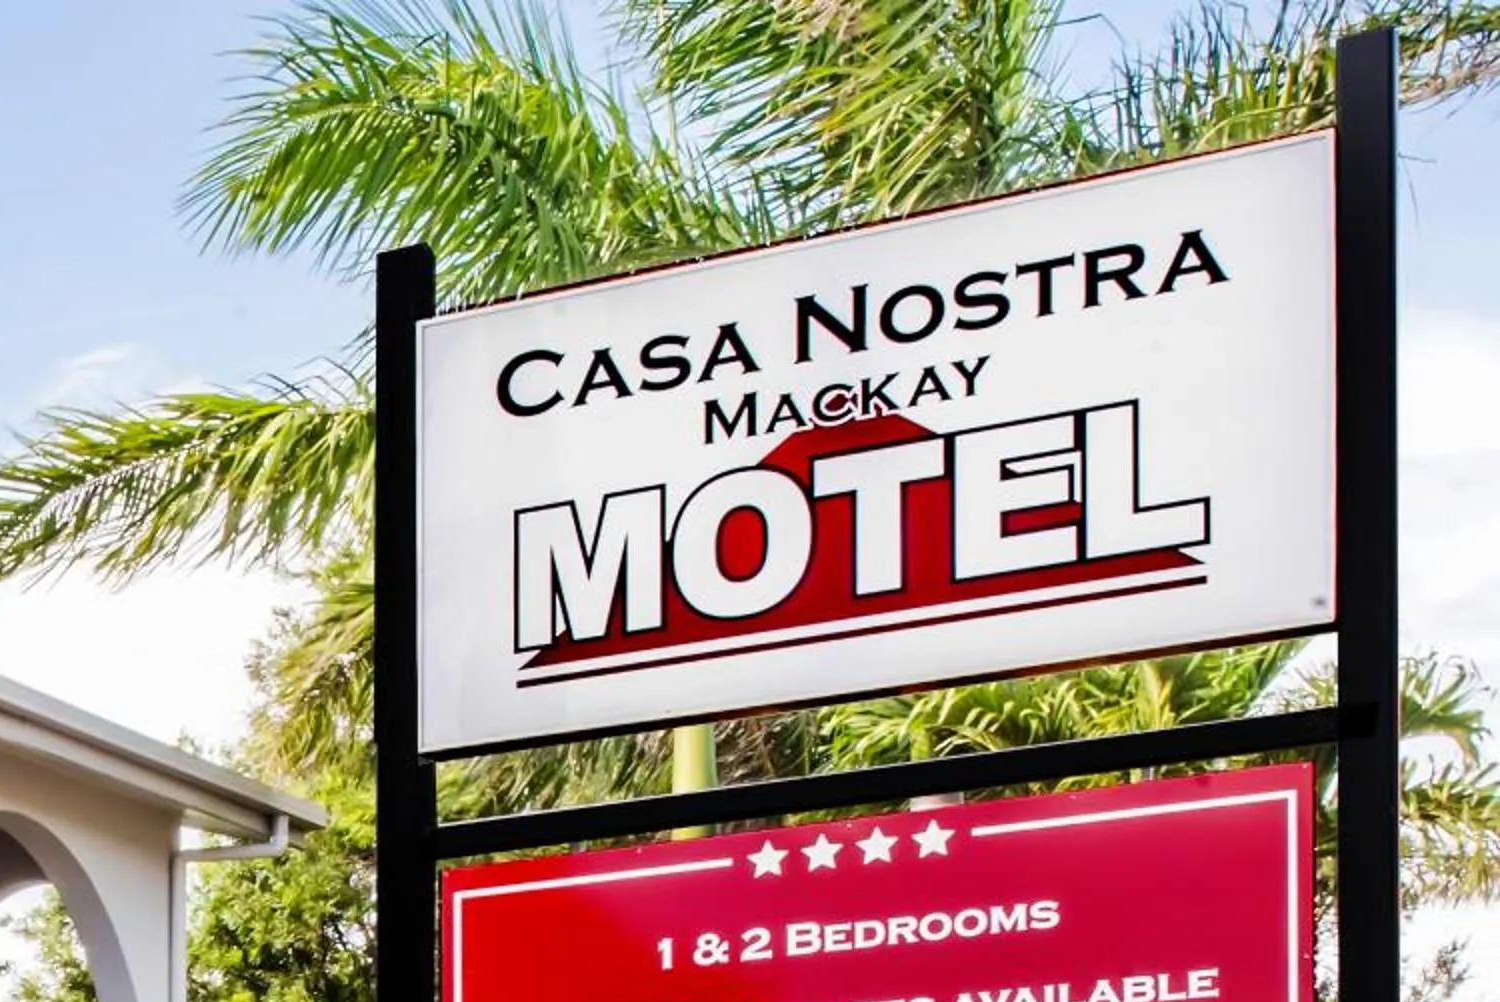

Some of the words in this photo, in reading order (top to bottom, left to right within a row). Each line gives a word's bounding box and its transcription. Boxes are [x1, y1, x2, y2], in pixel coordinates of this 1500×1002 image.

[496, 322, 760, 418] CASA
[794, 229, 1230, 365] NOSTRA
[704, 354, 991, 446] MACKAY
[514, 399, 1211, 654] MOTEL
[657, 937, 674, 970] 1
[692, 933, 728, 966] &
[742, 928, 773, 961] 2
[785, 900, 1060, 957] BEDROOMS
